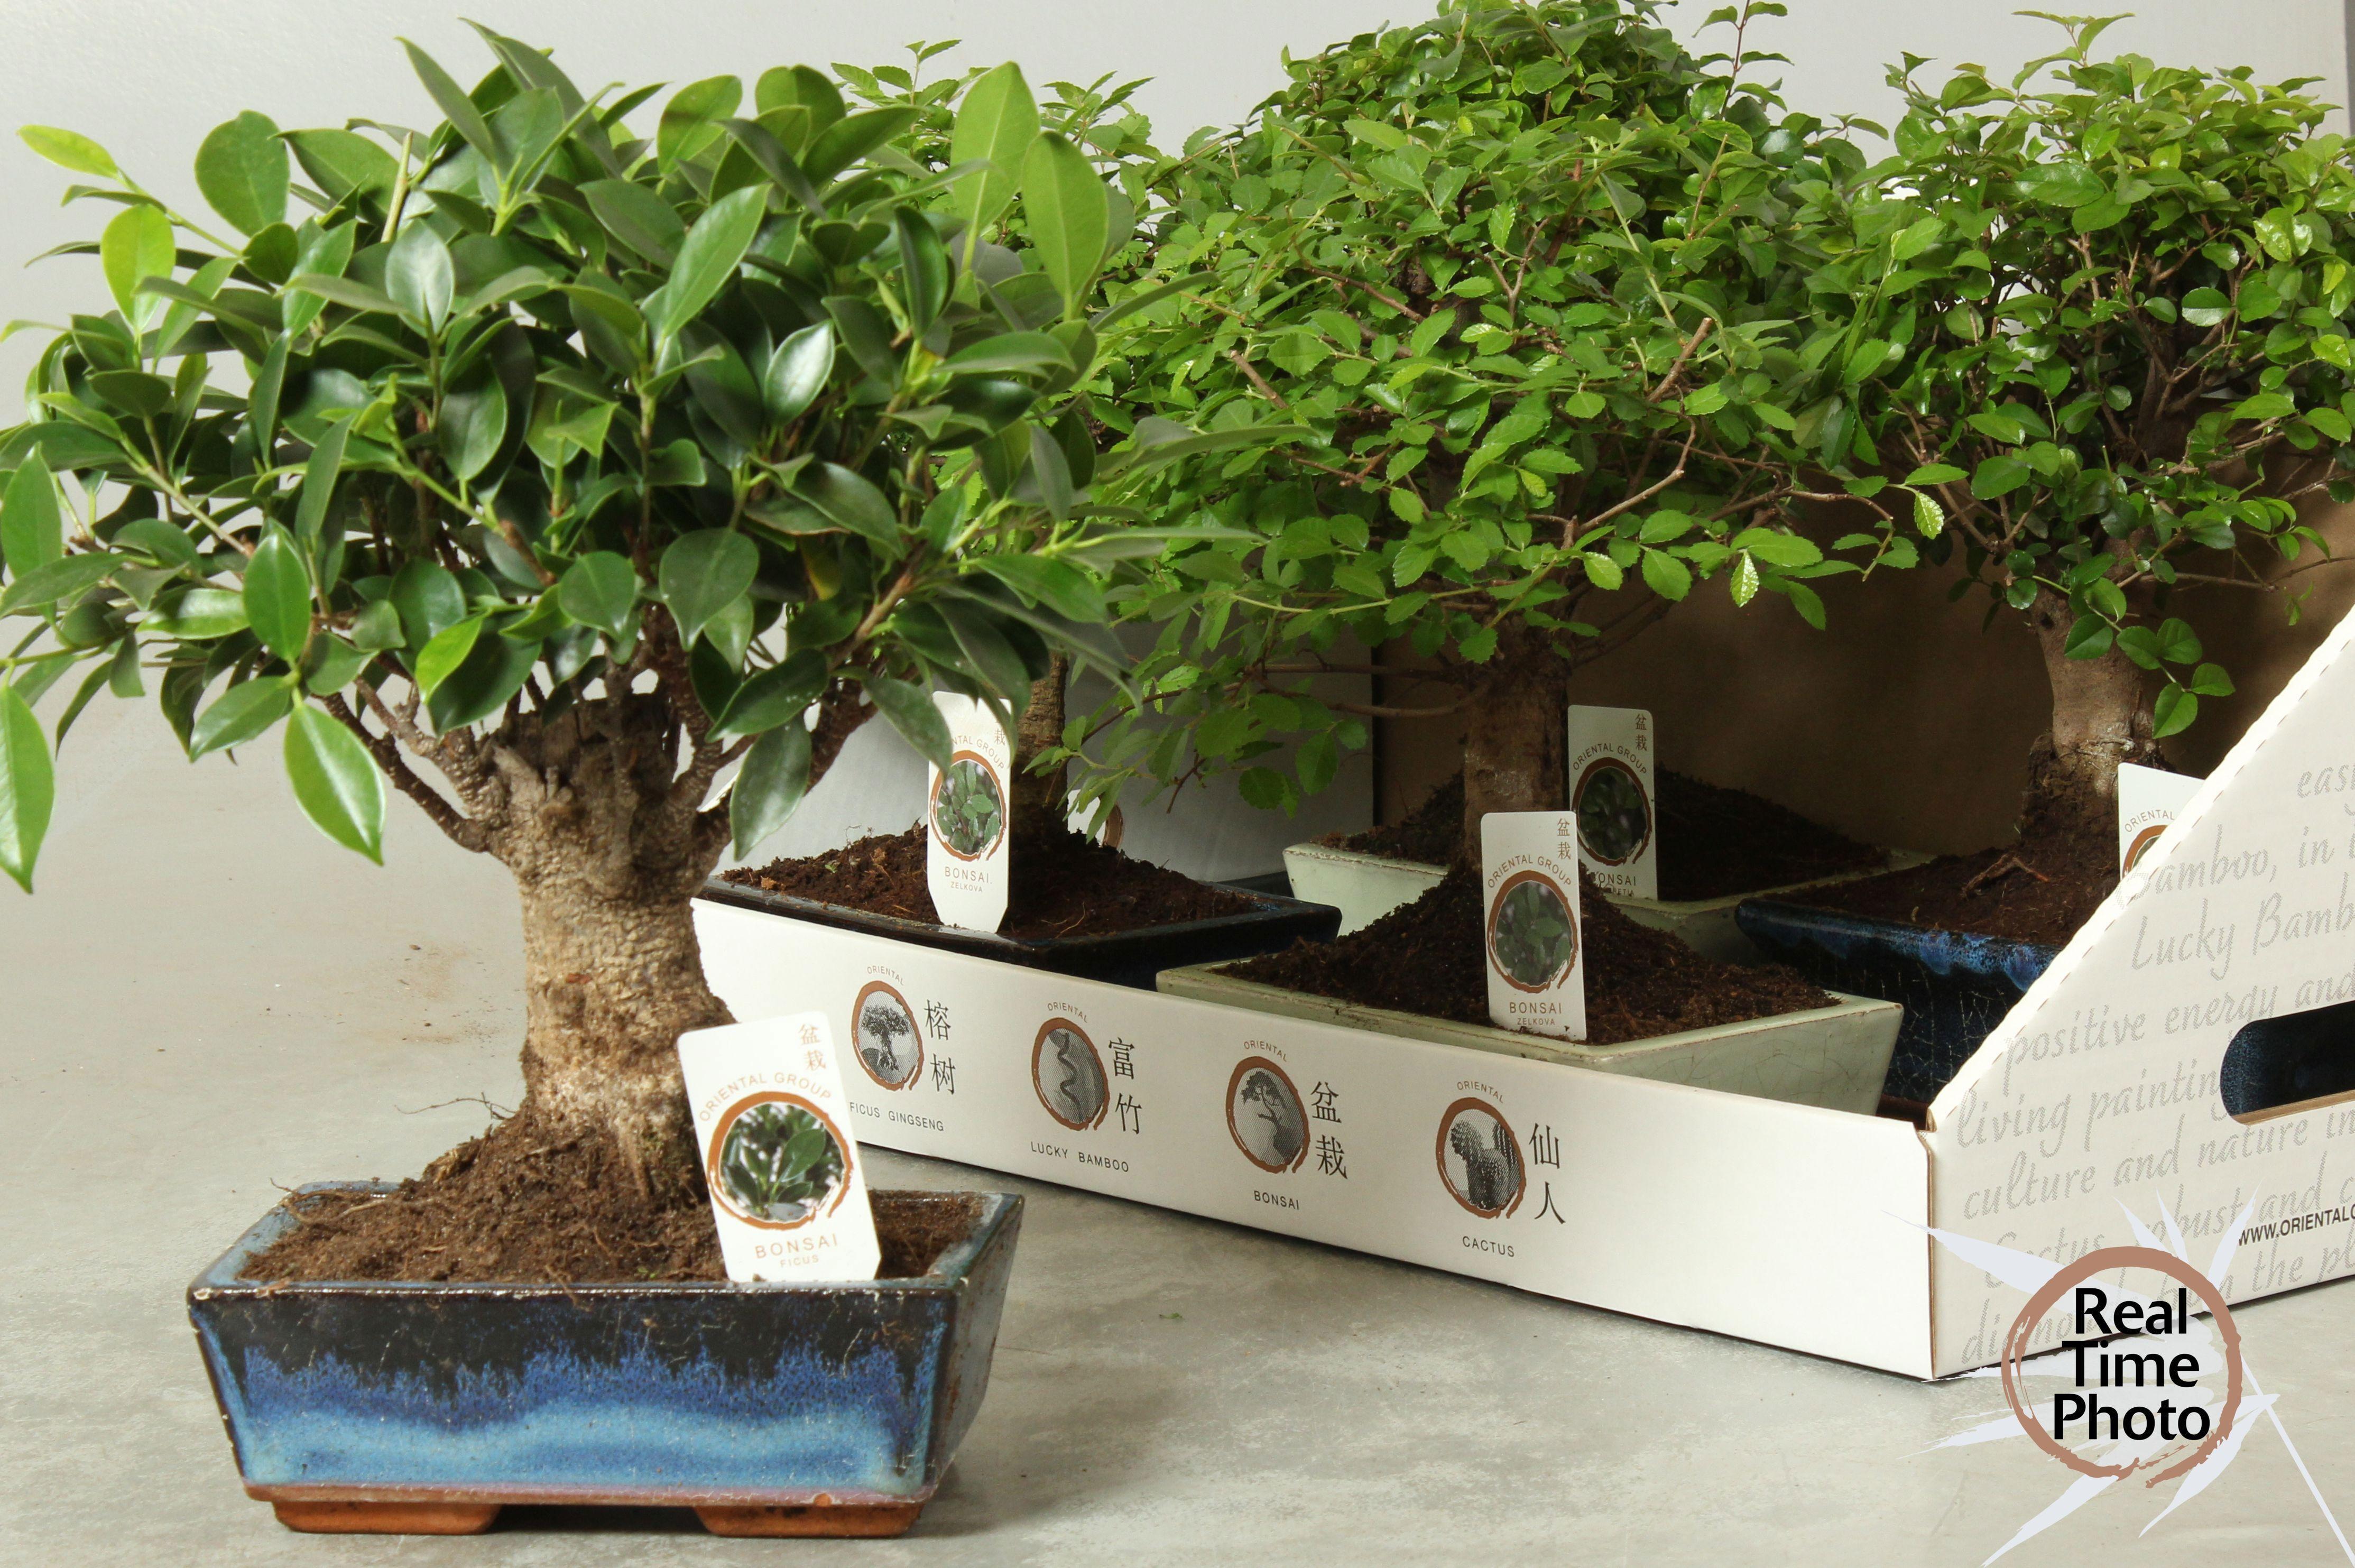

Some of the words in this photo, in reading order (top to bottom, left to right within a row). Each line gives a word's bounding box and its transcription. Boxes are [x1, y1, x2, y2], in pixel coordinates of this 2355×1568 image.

[1635, 714, 1647, 751] 盆栽
[952, 735, 973, 745] NTAL
[977, 739, 1005, 769] GROUP
[1573, 743, 1613, 771] ORIENTAL
[1618, 745, 1647, 774] GROUP
[2125, 809, 2175, 833] ORIENTAL
[1557, 818, 1572, 860] 盆栽
[2298, 825, 2335, 868] in
[950, 881, 983, 893] ZELKOVA
[1488, 854, 1534, 889] ORIENTAL
[1537, 855, 1572, 887] GROUP
[1596, 872, 1636, 886] ONSAI
[2131, 898, 2236, 981] Lucky
[867, 965, 904, 986] ORIENTAL
[1048, 1001, 1087, 1023] ORIENTAL
[1510, 1001, 1562, 1014] BONSAI
[1517, 1017, 1555, 1026] ZELKOVA
[798, 1023, 827, 1071] 盆栽
[923, 999, 956, 1096] 榕树
[1244, 1039, 1287, 1063] ORIENTAL
[2003, 1004, 2146, 1097] positive
[699, 1073, 768, 1122] ORIENTAL
[774, 1071, 832, 1101] GROUP
[1108, 1037, 1142, 1135] 富竹
[1457, 1080, 1504, 1104] ORIENTAL
[849, 1102, 881, 1118] FICUS
[888, 1110, 944, 1132] GINGSENG
[1956, 1087, 2072, 1159] living
[2083, 1058, 2227, 1152] paintin
[1310, 1081, 1349, 1180] 盆栽
[1030, 1141, 1068, 1159] LUCKY
[1078, 1151, 1129, 1173] BAMBOO
[1529, 1122, 1566, 1225] 仙人
[1962, 1150, 2097, 1220] culture
[2113, 1113, 2186, 1187] and
[2197, 1118, 2308, 1168] nature
[1253, 1190, 1299, 1211] BONSAI
[2258, 1150, 2328, 1223] and
[754, 1233, 838, 1259] BONSAI
[779, 1254, 819, 1268] FICUS
[1462, 1235, 1515, 1258] CACTUS
